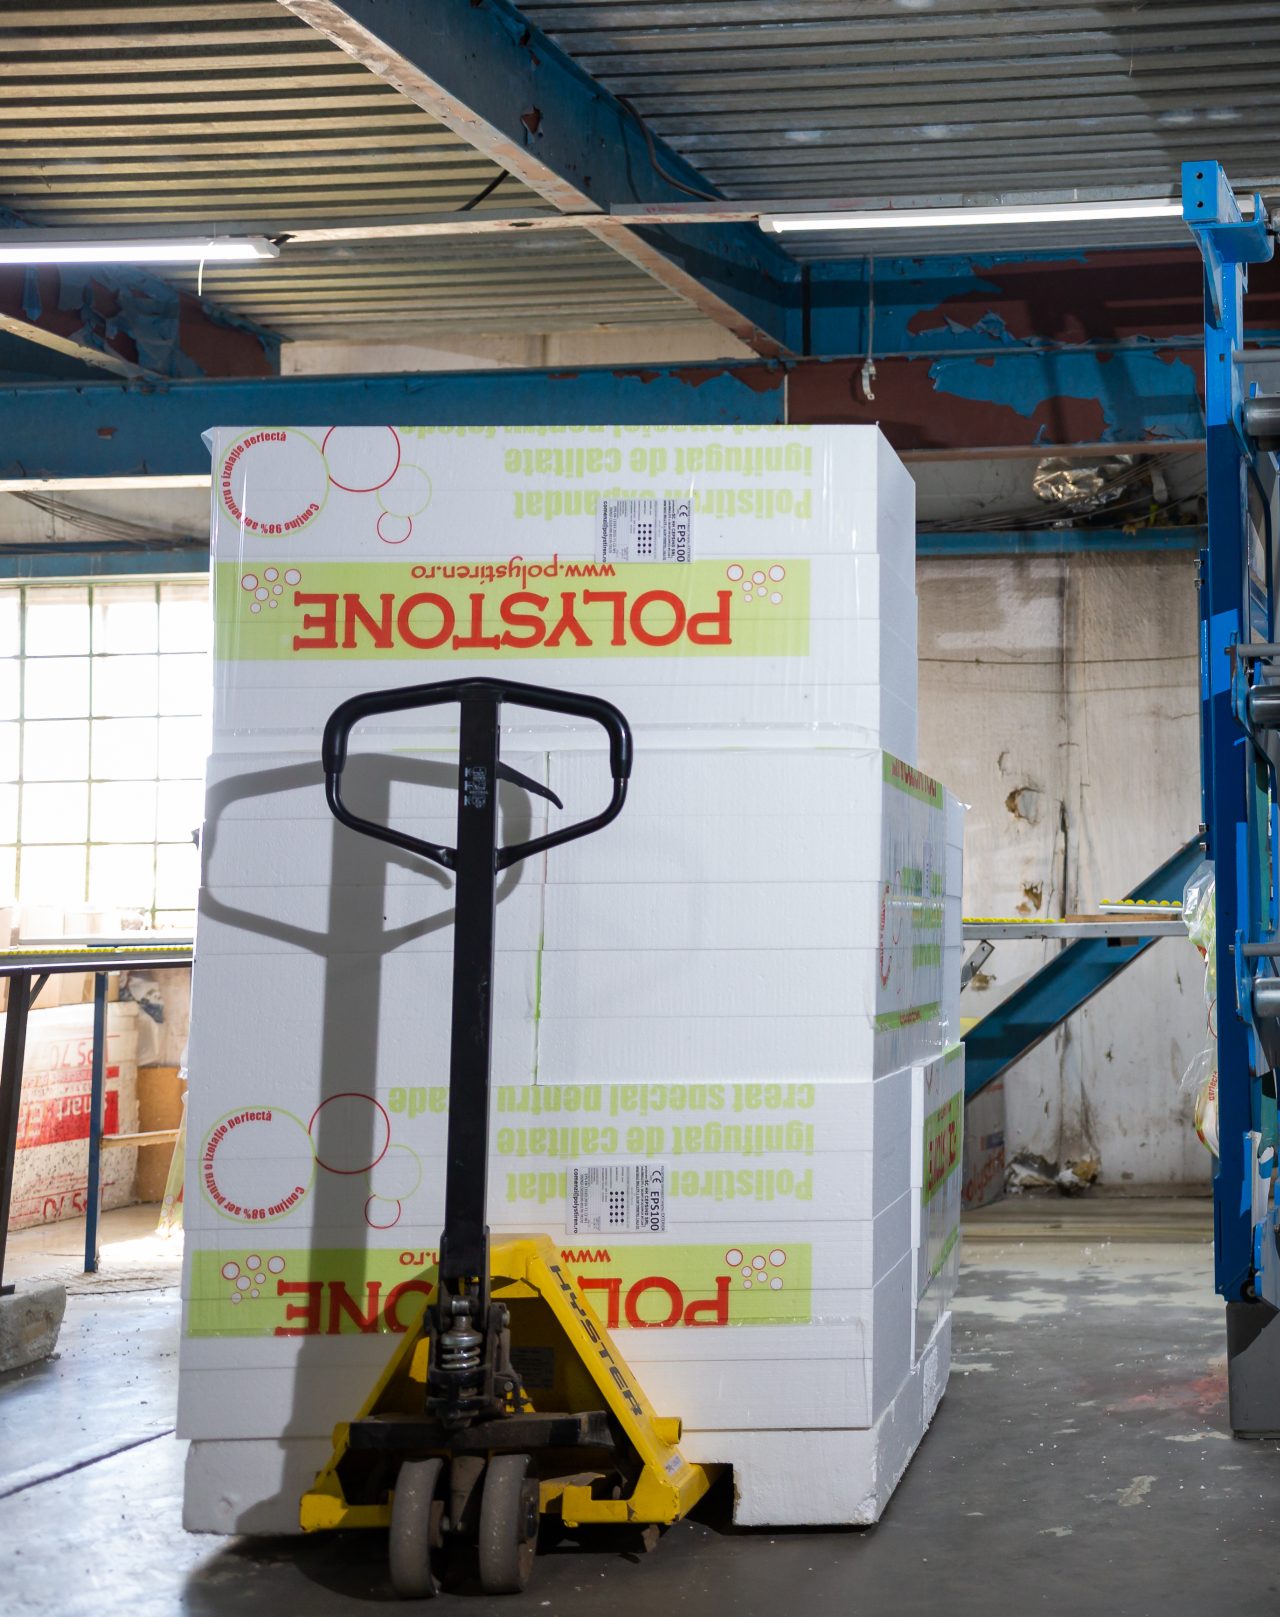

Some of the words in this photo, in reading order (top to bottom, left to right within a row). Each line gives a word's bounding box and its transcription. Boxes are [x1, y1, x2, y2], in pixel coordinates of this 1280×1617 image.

[503, 446, 623, 478] calitate
[629, 446, 668, 477] de
[674, 442, 813, 477] ignifugat
[260, 523, 282, 534] 98%
[676, 524, 686, 563] EPS100
[411, 556, 616, 590] www.polystiren.ro
[293, 589, 733, 652] POLYSTONE
[496, 1083, 602, 1116] pentru
[609, 1083, 726, 1117] special
[732, 1083, 815, 1112] creat
[227, 1110, 273, 1129] perfectă
[497, 1125, 619, 1159] calitate
[626, 1126, 665, 1157] de
[672, 1121, 815, 1156] ignifugat
[204, 1172, 226, 1205] pentru
[223, 1202, 242, 1216] aer
[243, 1208, 266, 1220] 98%
[650, 1191, 660, 1231] EPS100
[274, 1275, 732, 1337] POLONE
[550, 1264, 643, 1416] HYSTER
